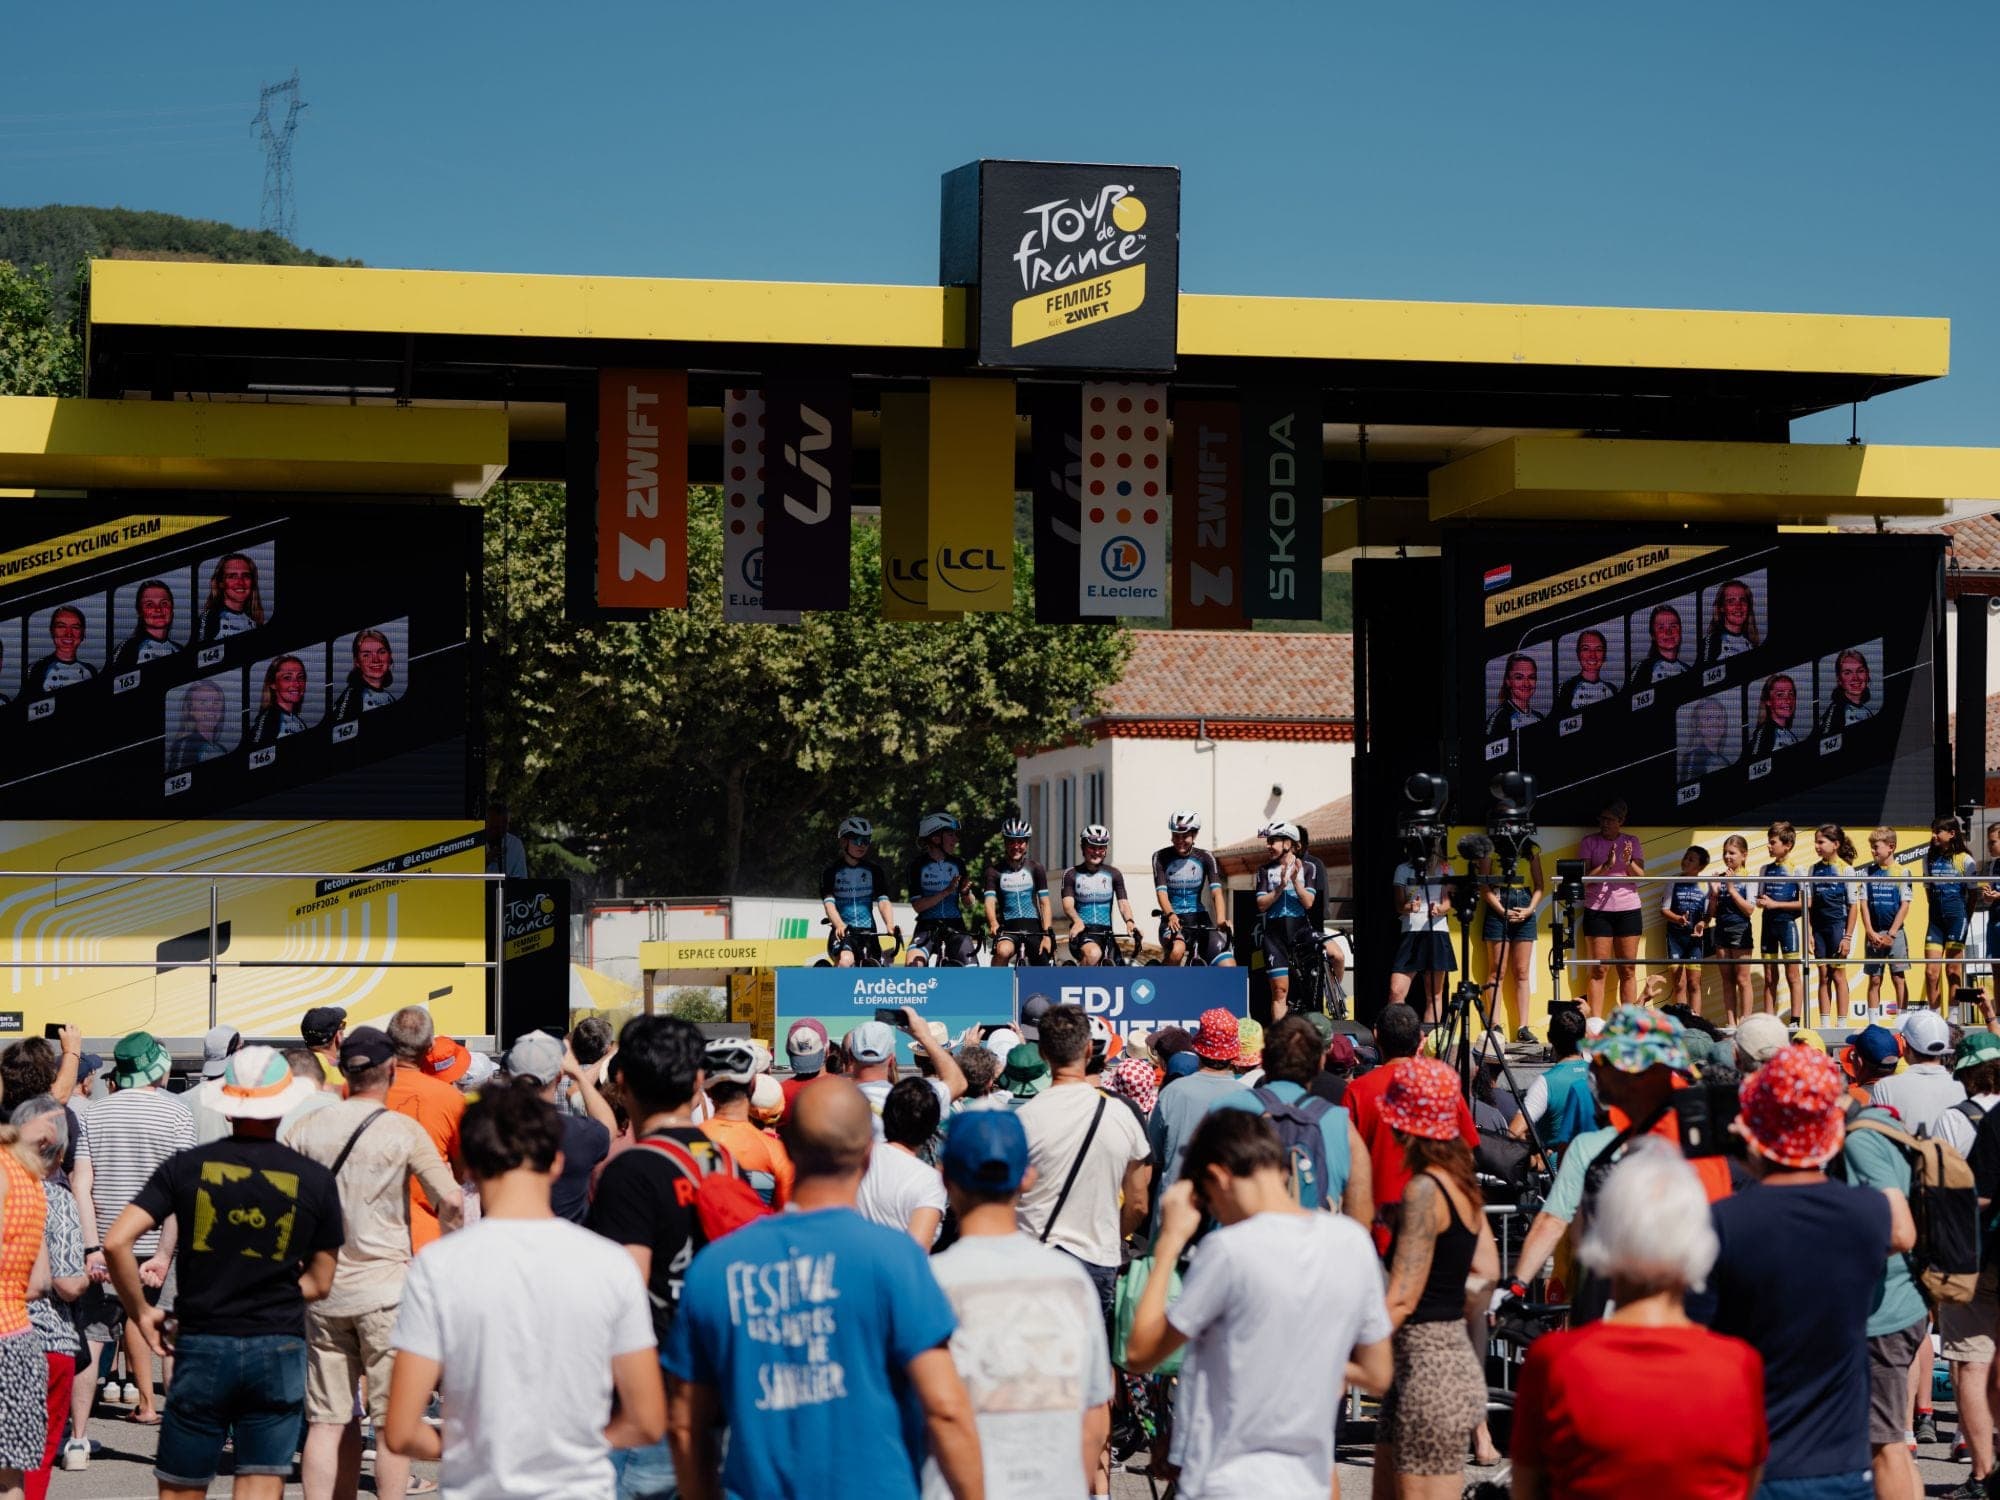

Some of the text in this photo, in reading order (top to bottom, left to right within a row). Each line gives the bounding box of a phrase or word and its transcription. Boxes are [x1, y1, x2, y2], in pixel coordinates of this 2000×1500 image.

[1096, 222, 1115, 242] de
[1046, 280, 1112, 313] FEMMES
[1064, 301, 1109, 324] ZWIFT
[627, 385, 659, 519] ZWIFT
[783, 402, 832, 524] Liv
[1198, 425, 1227, 549] ZWIFT
[66, 530, 119, 557] CYCLING
[122, 518, 161, 541] TEAM
[943, 547, 1006, 570] LCL
[893, 558, 929, 580] LC
[1087, 585, 1158, 598] E.Leclerc
[1494, 547, 1670, 616] VOLKERWESSELS CYCLING TEAM
[119, 675, 135, 689] 163
[337, 724, 355, 739] 167
[1491, 743, 1503, 755] 161
[1824, 739, 1838, 750] 167
[253, 750, 271, 765] 166
[170, 776, 187, 791] 165
[1682, 786, 1696, 799] 165
[402, 837, 475, 867] @LeTourFemmes
[295, 896, 339, 916] #TDFF2026
[679, 947, 757, 960] ESPACE COURSE
[853, 978, 927, 994] Ardèche
[853, 995, 928, 1005] LE DÉPARTEMENT
[1854, 1004, 1883, 1016] UI
[726, 1247, 841, 1326] FESTIVAL
